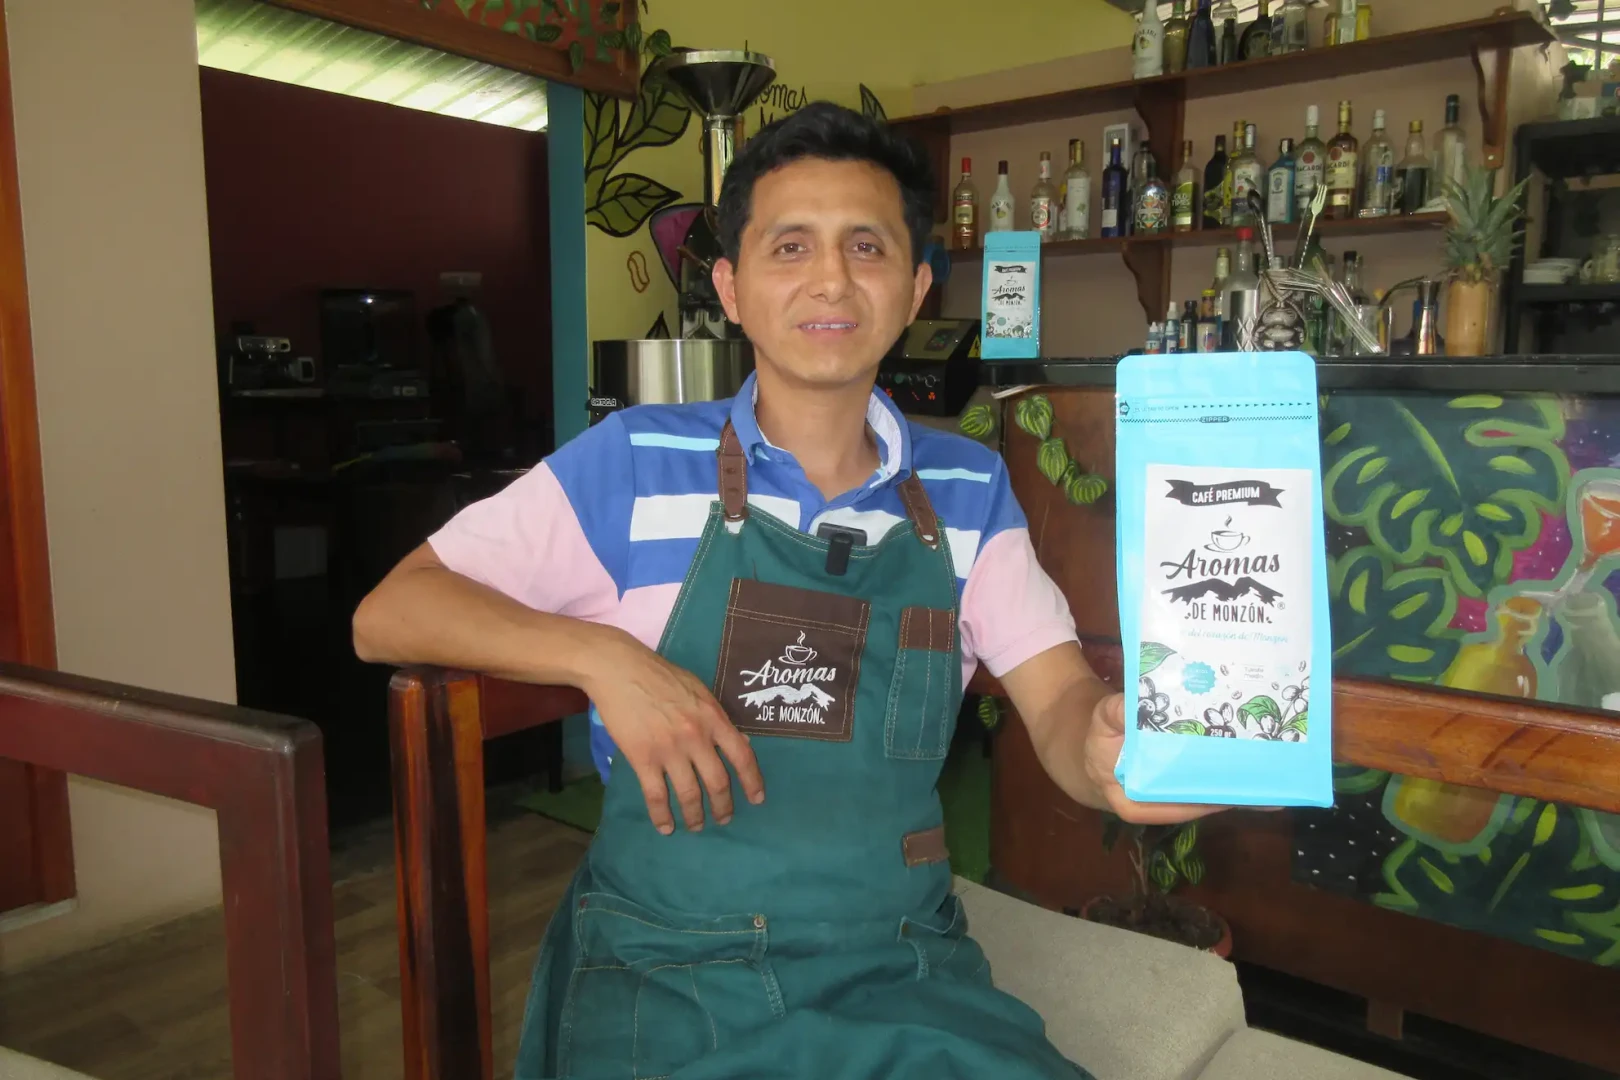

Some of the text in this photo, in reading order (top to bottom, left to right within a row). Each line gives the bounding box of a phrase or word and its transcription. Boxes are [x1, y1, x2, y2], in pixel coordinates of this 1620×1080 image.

[1192, 486, 1260, 503] CAFÉ PREMIUM
[1160, 549, 1280, 579] Aromas
[1192, 602, 1265, 623] DE MONZÓN
[739, 659, 837, 686] Aromas
[762, 703, 820, 724] DE MONZÓN
[1210, 728, 1223, 737] 250
